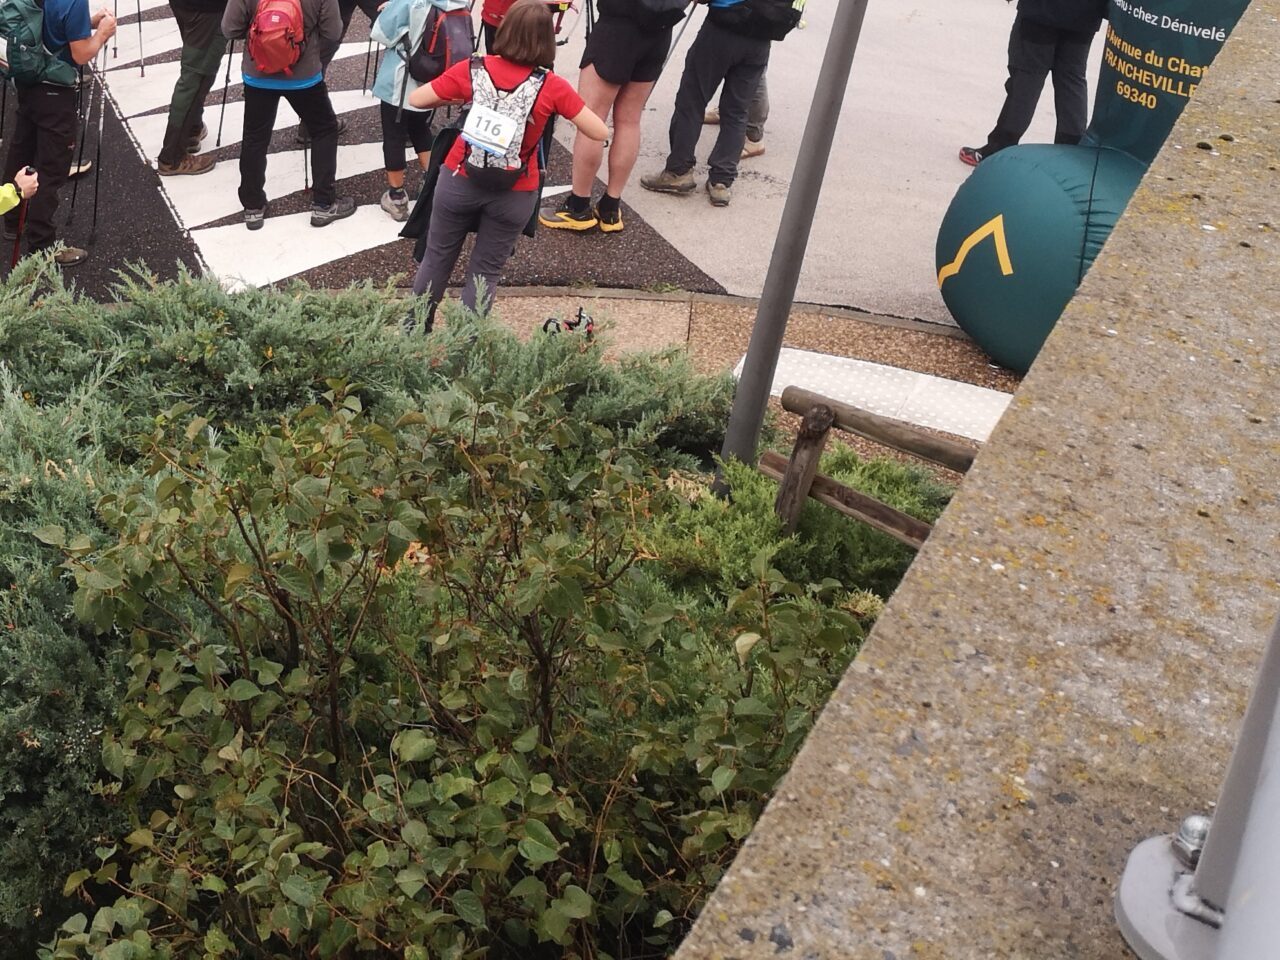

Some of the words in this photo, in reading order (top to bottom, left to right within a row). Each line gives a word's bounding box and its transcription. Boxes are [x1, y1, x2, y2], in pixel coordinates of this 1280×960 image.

[1133, 5, 1159, 26] chez
[1160, 14, 1226, 43] Dénivelé
[1144, 49, 1164, 68] du
[1116, 80, 1157, 110] 69340
[475, 116, 503, 137] 116
